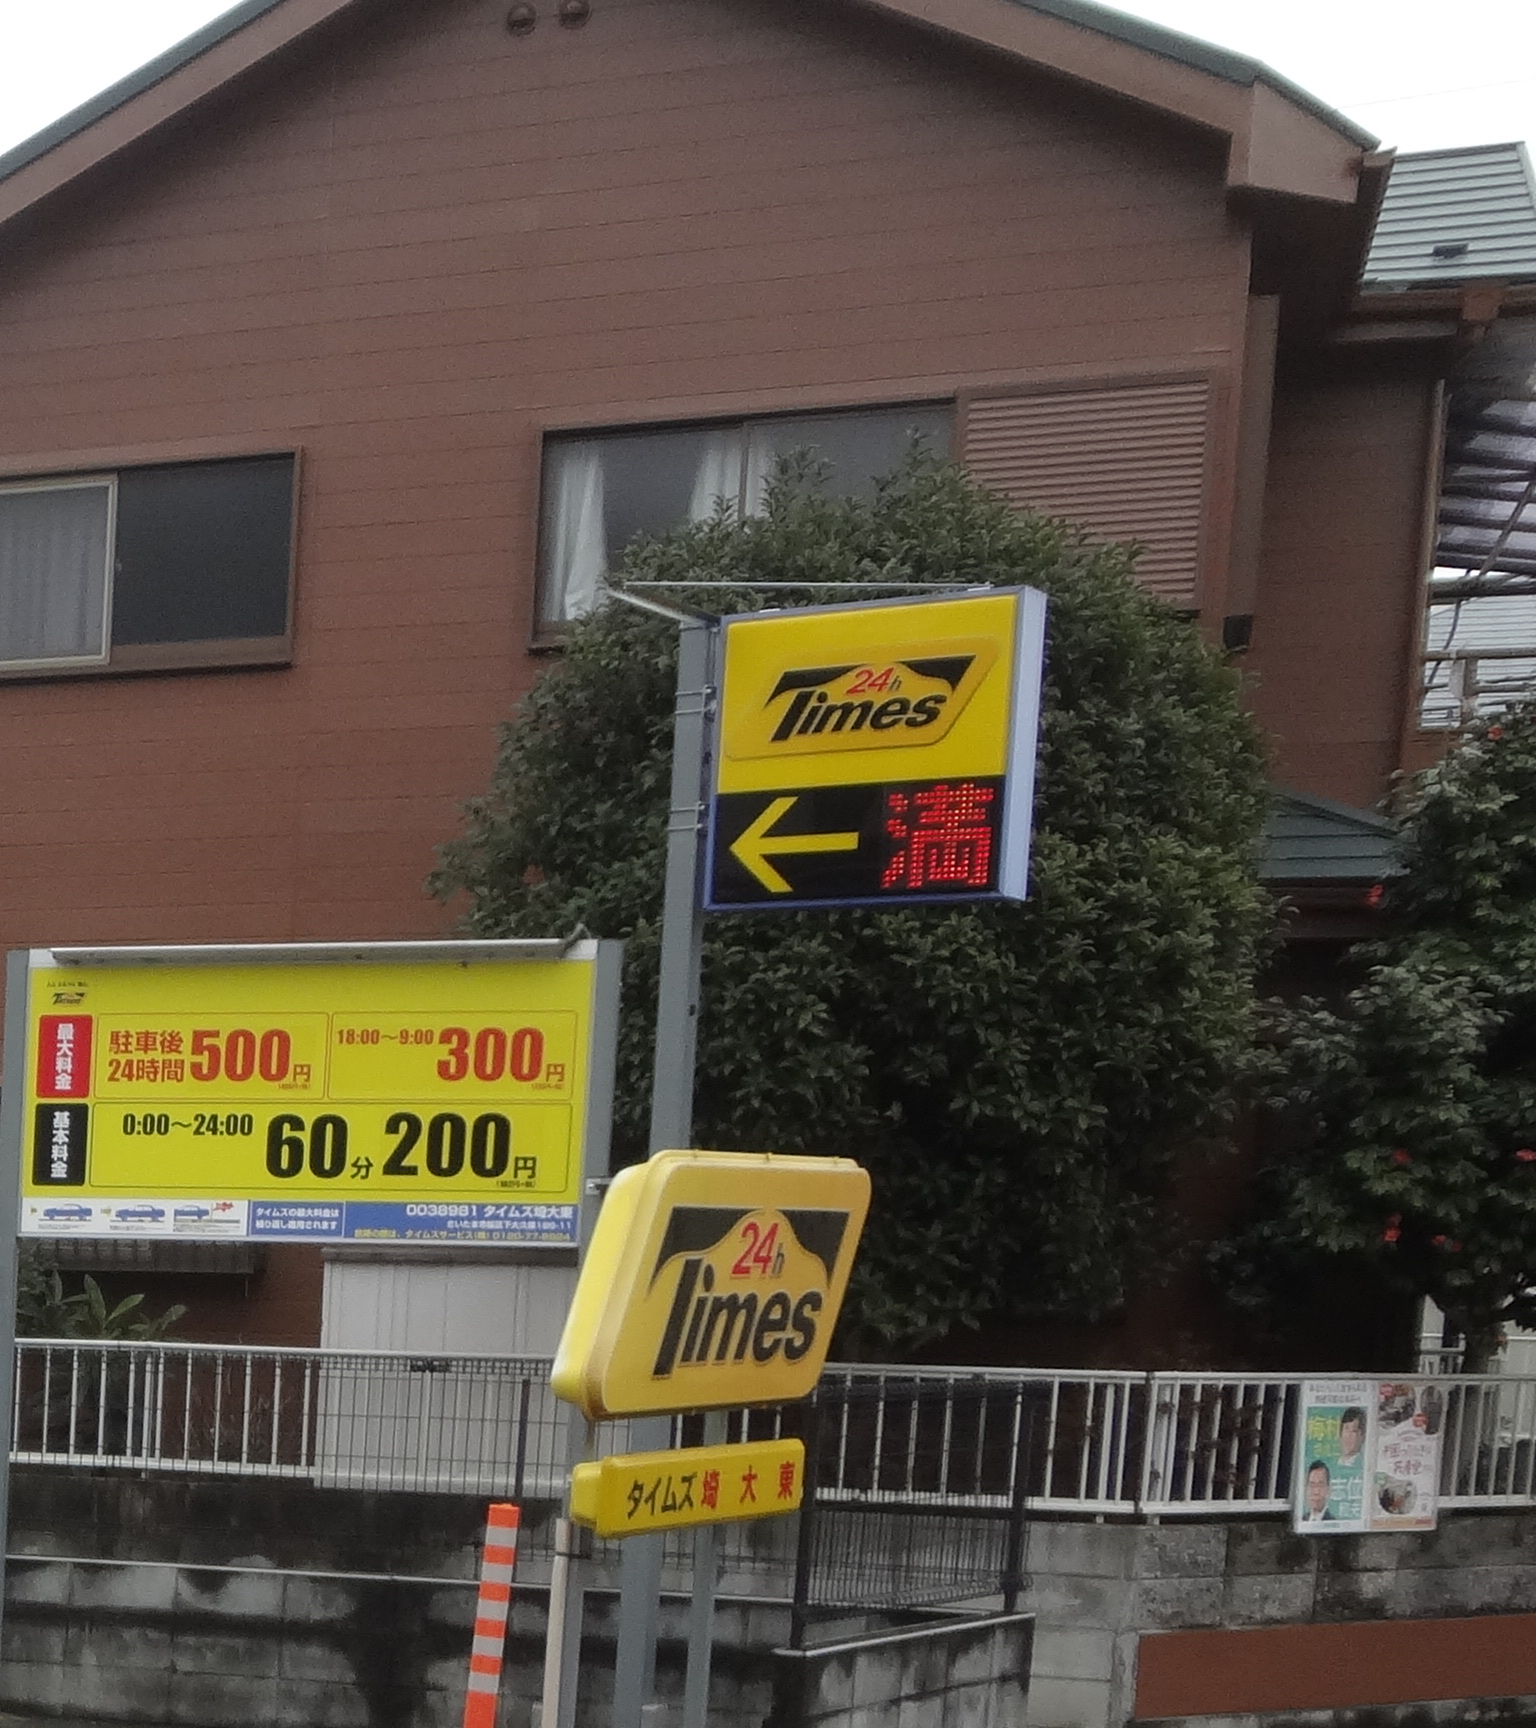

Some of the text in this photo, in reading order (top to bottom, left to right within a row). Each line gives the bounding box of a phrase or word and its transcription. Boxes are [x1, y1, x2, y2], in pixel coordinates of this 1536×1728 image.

[845, 667, 902, 697] 24h
[770, 690, 948, 743] Times
[880, 782, 995, 890] 満
[54, 1022, 75, 1092] 最大料金
[107, 1057, 186, 1083] 24時間
[108, 1029, 185, 1056] 駐車後
[50, 1110, 71, 1179] 基本料金
[731, 1221, 785, 1280] 24h
[651, 1257, 824, 1380] Times
